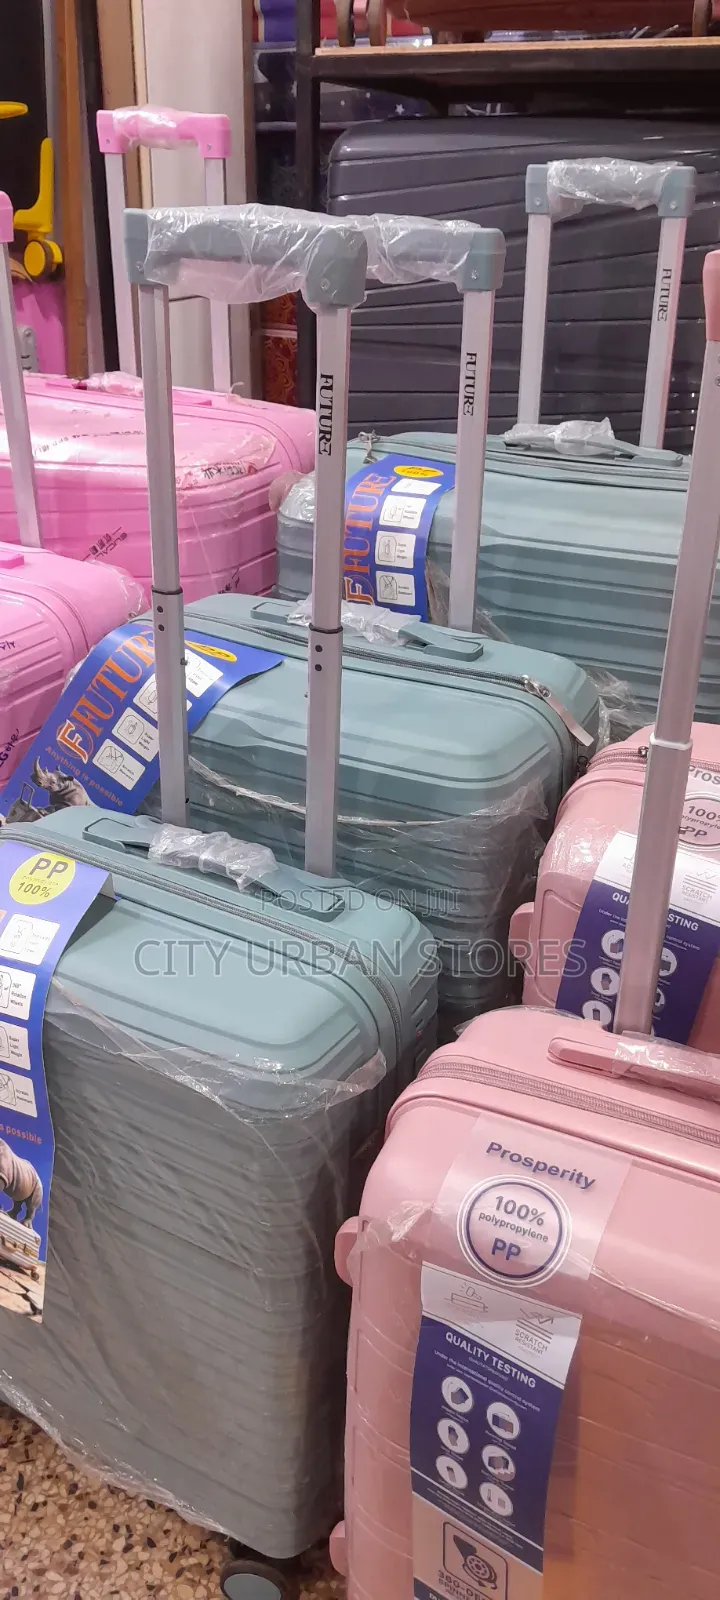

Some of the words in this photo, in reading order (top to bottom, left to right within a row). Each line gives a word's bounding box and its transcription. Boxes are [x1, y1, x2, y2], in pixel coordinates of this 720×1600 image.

[657, 268, 672, 322] FUTURE
[463, 352, 477, 416] FUTURE
[318, 373, 334, 456] FUTURE
[343, 472, 397, 576] FUTURE
[70, 630, 155, 737] FUTUR
[29, 858, 68, 879] PP
[18, 882, 52, 898] 100%
[6, 1126, 42, 1145] possible
[486, 1141, 596, 1190] Prosperity
[478, 1212, 549, 1243] polypropylene
[495, 1195, 546, 1226] 100%
[491, 1237, 522, 1261] PP
[445, 1332, 490, 1361] QUALITY
[491, 1354, 536, 1388] TESTING
[514, 1328, 548, 1352] SCRATCH
